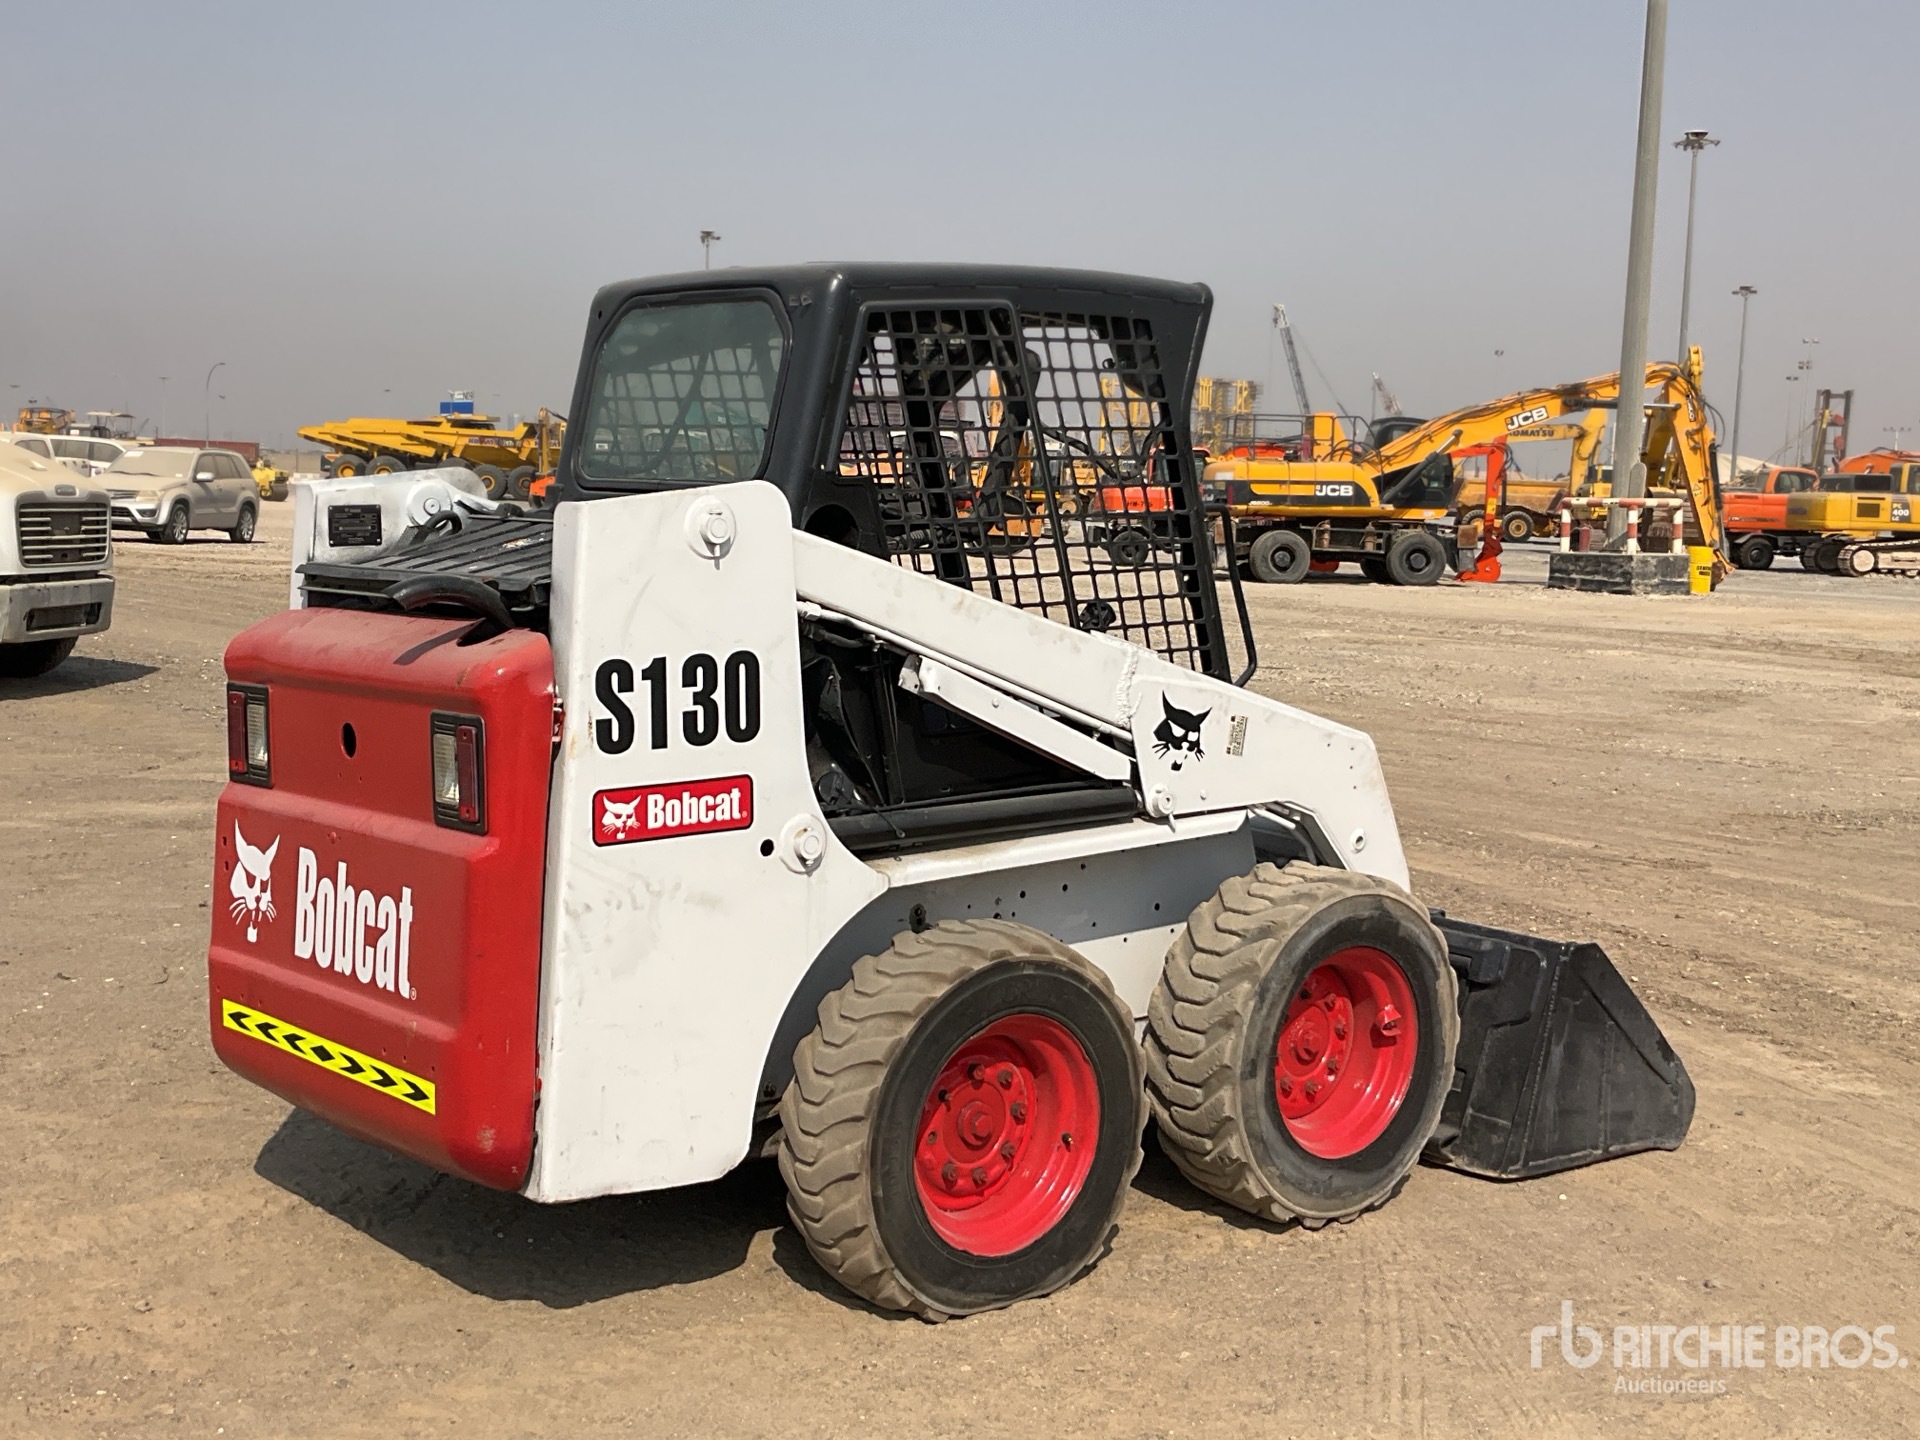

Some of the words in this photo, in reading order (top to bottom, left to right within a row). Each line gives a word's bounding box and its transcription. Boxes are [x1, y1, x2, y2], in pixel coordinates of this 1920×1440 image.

[1507, 406, 1548, 430] JCB
[1316, 484, 1354, 496] JCB
[1892, 509, 1910, 517] 400
[594, 649, 761, 755] S130
[646, 787, 742, 830] Bobcat
[294, 846, 414, 999] Bobcat
